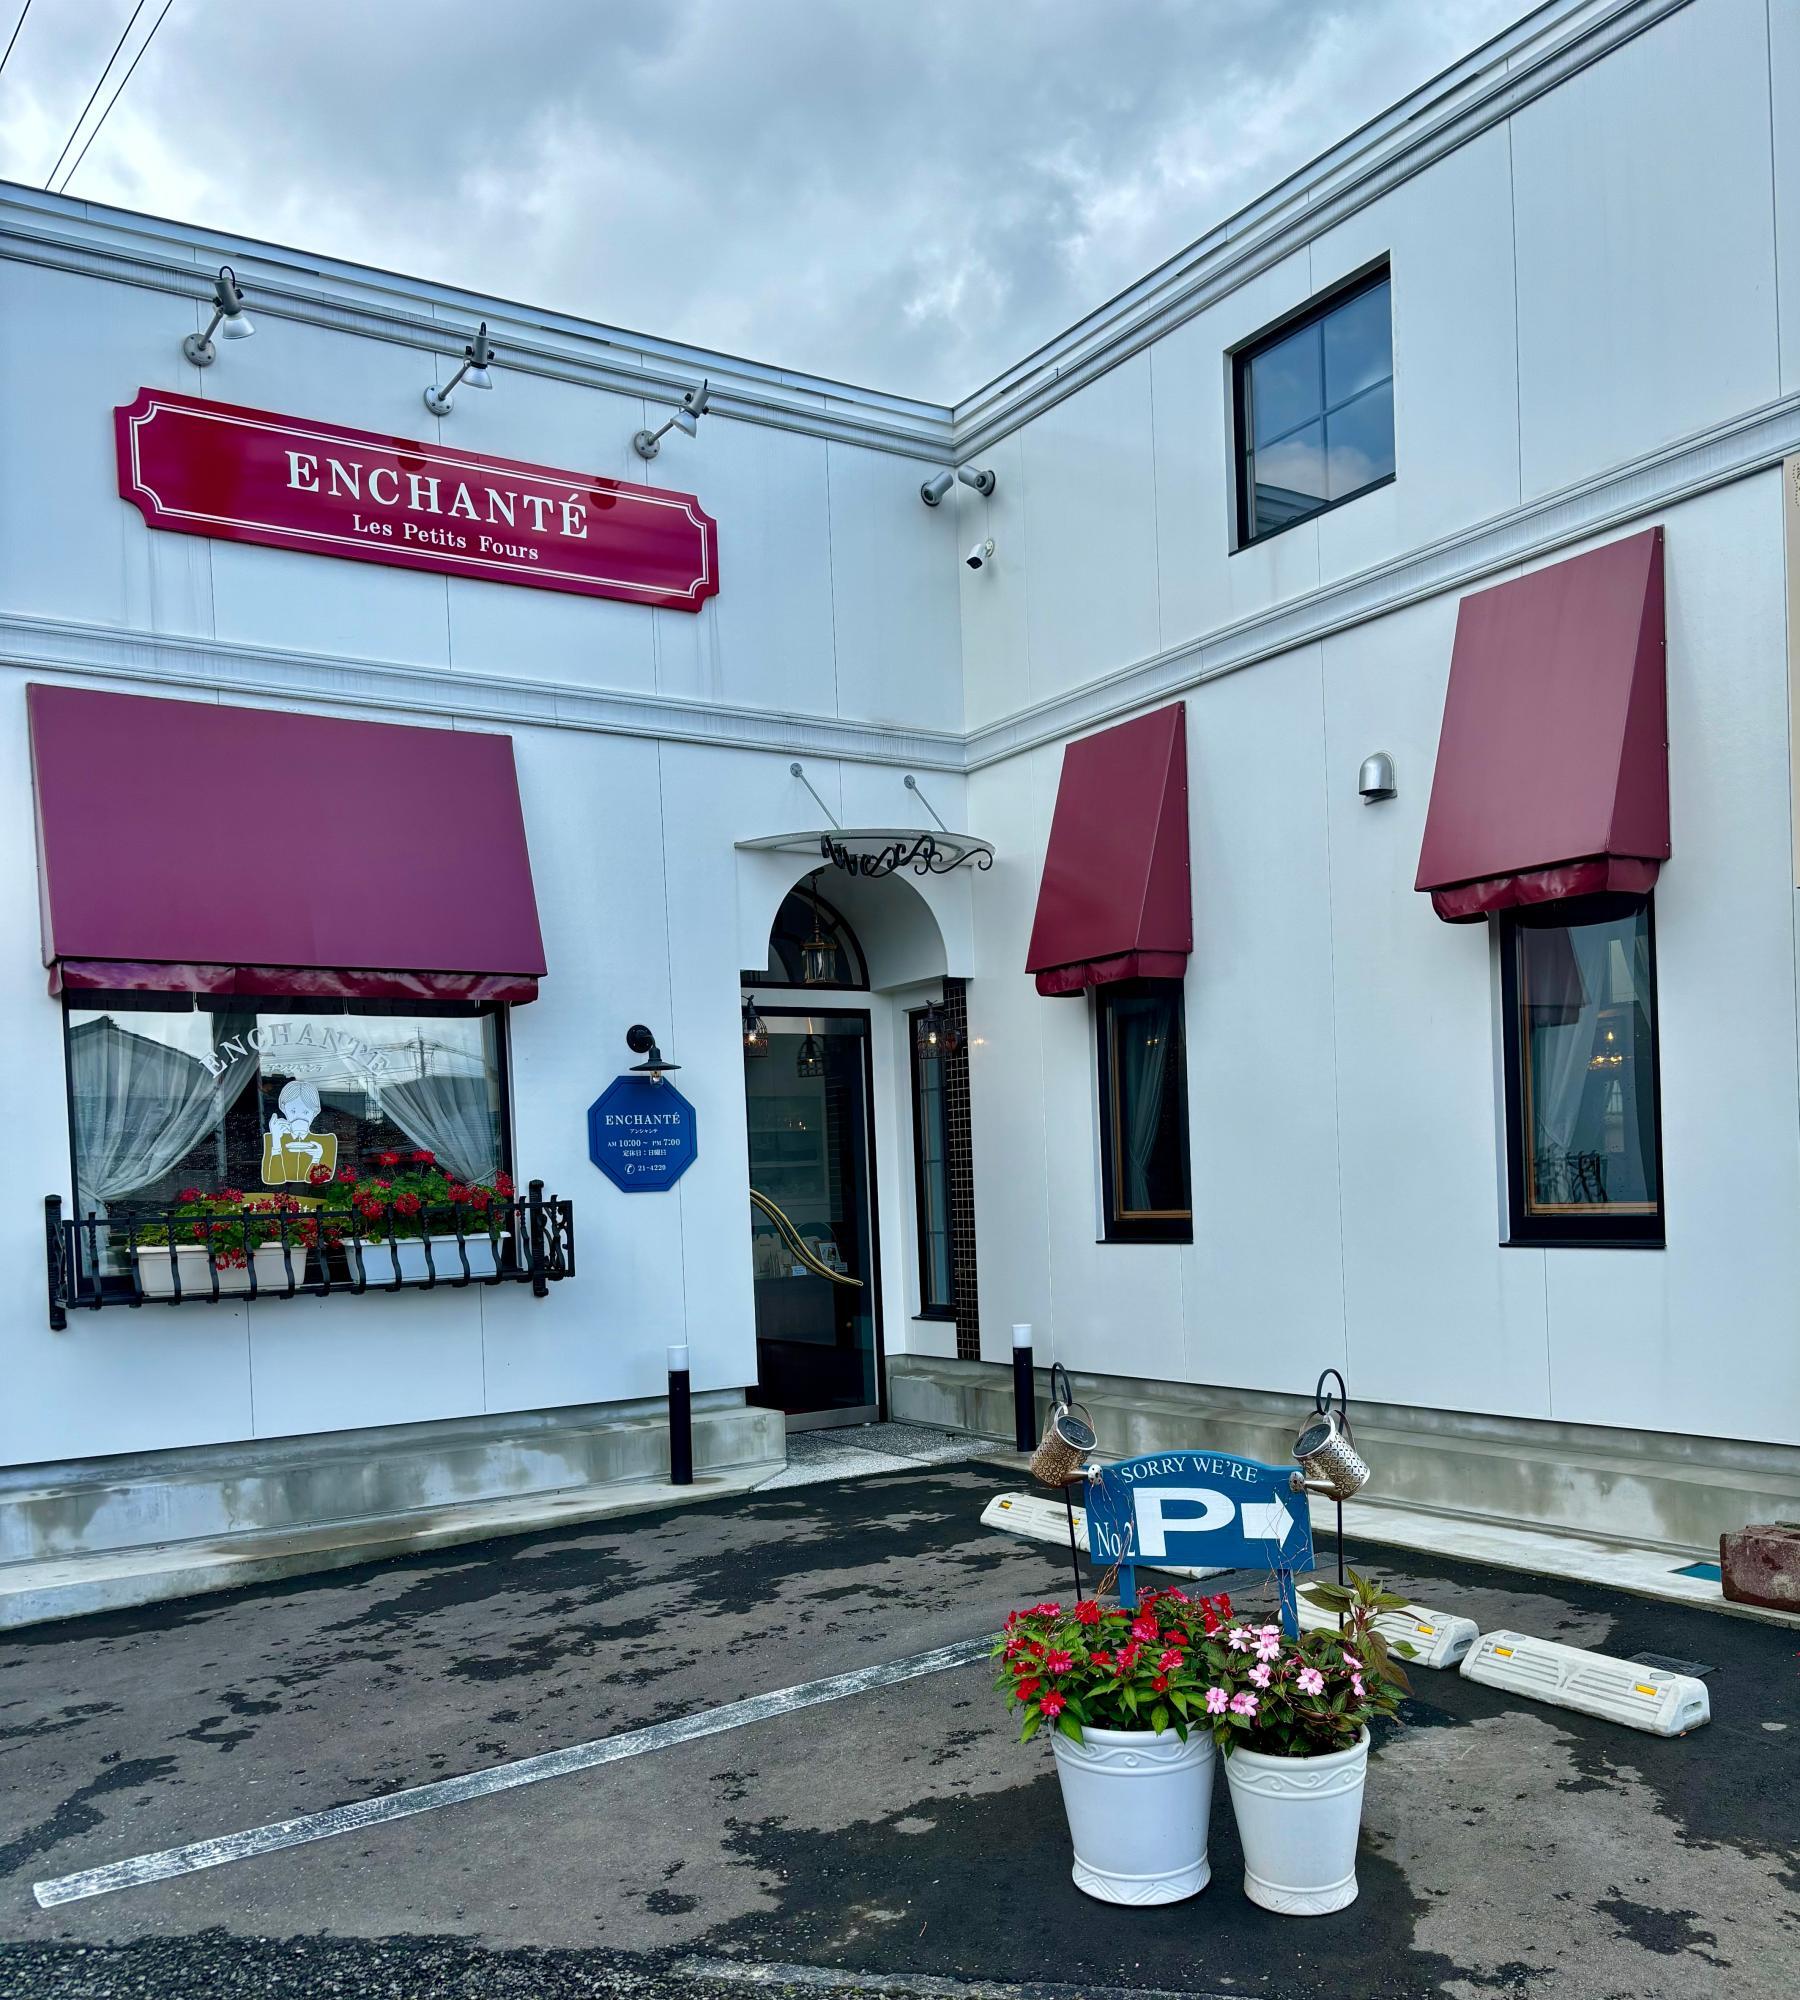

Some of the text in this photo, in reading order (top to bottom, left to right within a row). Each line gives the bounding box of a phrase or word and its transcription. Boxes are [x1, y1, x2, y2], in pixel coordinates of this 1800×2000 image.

[285, 451, 588, 540] ENCHANTÉ
[352, 514, 539, 562] Les Petits Fours
[605, 1112, 680, 1125] ENCHANTÉ
[663, 1138, 680, 1146] 7:00
[1121, 1456, 1259, 1484] SORRY WE'RE
[1133, 1487, 1236, 1557] P
